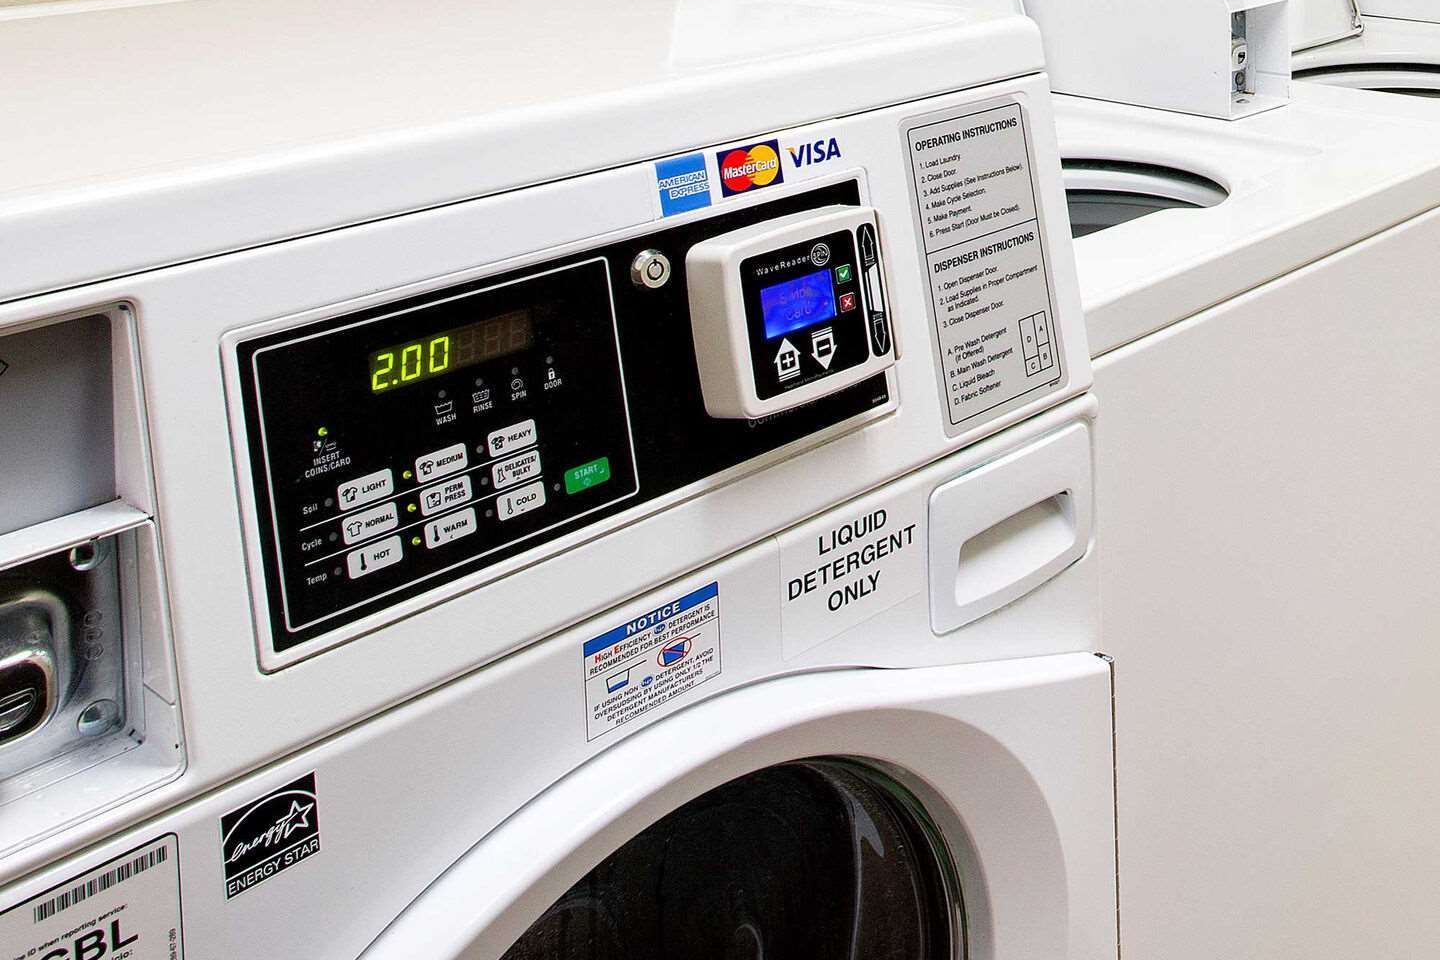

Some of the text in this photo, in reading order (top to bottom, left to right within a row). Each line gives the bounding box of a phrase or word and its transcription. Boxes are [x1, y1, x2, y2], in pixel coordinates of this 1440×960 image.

[915, 117, 1017, 151] OPERATING INSTRUCTIONS
[787, 138, 841, 168] VISA
[724, 157, 777, 180] MasterCard
[658, 172, 705, 189] AMERICAN
[930, 187, 940, 195] Add
[941, 182, 963, 192] Supplies
[964, 177, 976, 187] (See
[977, 168, 1005, 181] Instructions
[670, 182, 709, 198] EXPRESS
[934, 232, 1034, 273] DISPENSER INSTRUCTIONS
[756, 256, 810, 276] WaveReader
[371, 337, 449, 392] 2.00
[957, 365, 970, 375] Main
[971, 357, 986, 370] Wash
[988, 347, 1013, 365] Detergent
[544, 378, 562, 390] DOOR
[959, 376, 976, 388] Liquid
[977, 369, 995, 380] Bleach
[511, 390, 527, 400] SPIN
[961, 390, 978, 402] Fabric
[979, 381, 1001, 394] Softener
[473, 401, 493, 413] RINSE
[436, 413, 457, 425] WASH
[507, 429, 532, 442] HEAVY
[313, 451, 340, 466] INSERT
[436, 453, 463, 467] MEDIUM
[505, 455, 537, 472] DELICATES/
[512, 465, 531, 477] BULKY
[575, 465, 598, 479] START
[362, 480, 386, 493] LIGHT
[445, 482, 463, 494] PERM
[445, 490, 466, 503] PRESS
[516, 493, 537, 506] COLD
[303, 504, 318, 515] Soil
[365, 513, 394, 528] NORMAL
[443, 520, 468, 533] WARM
[819, 509, 887, 555] LIQUID
[302, 538, 322, 551] Cycle
[374, 549, 391, 561] HOT
[788, 524, 916, 601] DETERGENT
[306, 573, 327, 585] Temp
[828, 571, 881, 612] ONLY
[626, 602, 681, 635] NOTICE
[590, 610, 714, 676] RECOMMENDED FOR BEST PERFORMANCE
[595, 649, 612, 663] HIGH
[614, 632, 651, 654] EFFICIENCY
[669, 607, 702, 628] DETERGENT
[229, 838, 319, 895] ENERGY STAR
[28, 948, 36, 957] ID
[39, 937, 59, 951] when
[61, 919, 96, 939] reporting
[98, 904, 127, 922] service:
